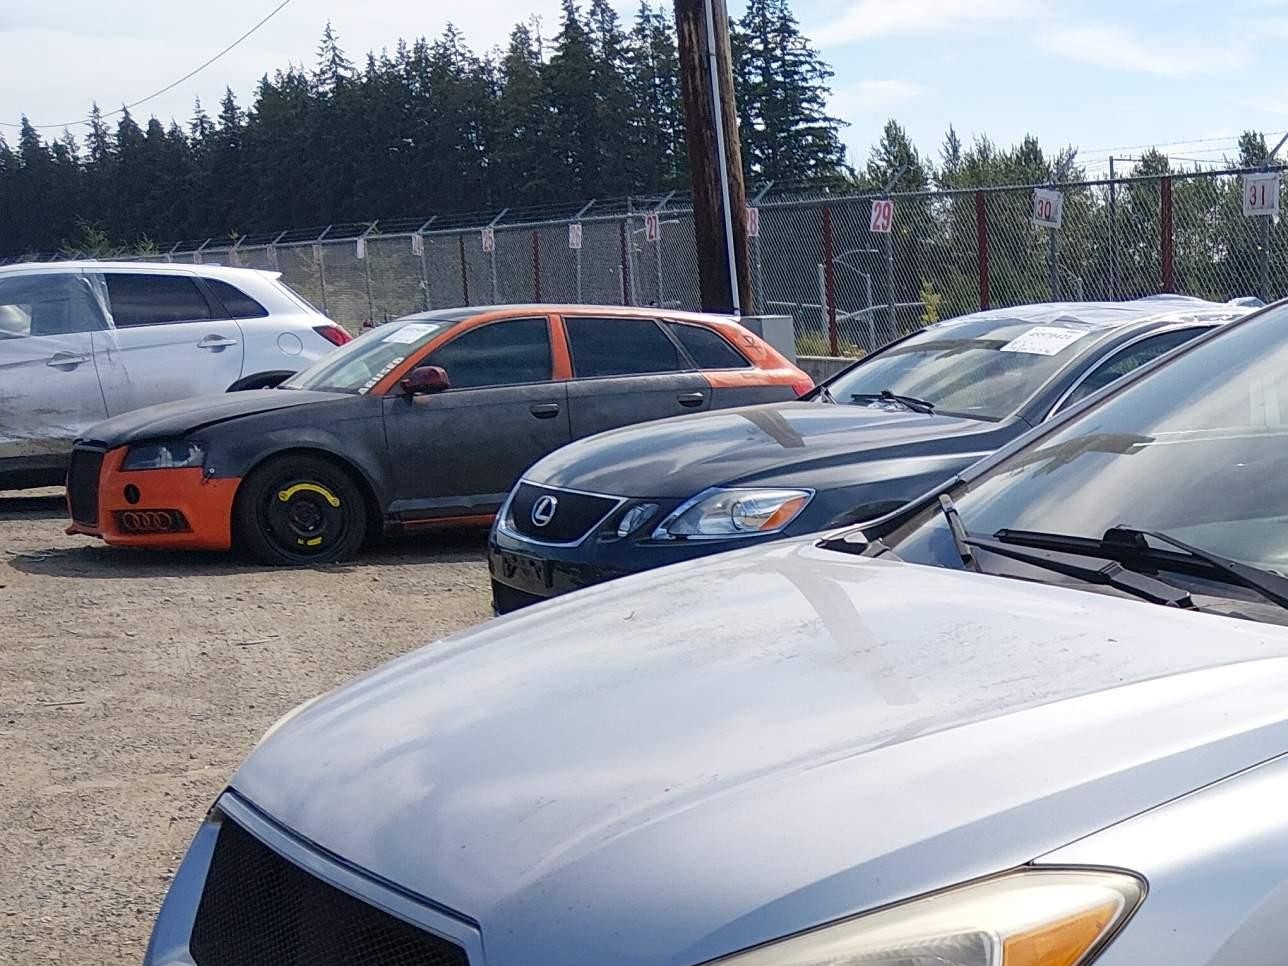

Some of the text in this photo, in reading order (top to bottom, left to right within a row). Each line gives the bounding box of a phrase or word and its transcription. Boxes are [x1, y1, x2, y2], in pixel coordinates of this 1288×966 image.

[1249, 184, 1265, 206] 31
[872, 202, 891, 231] 29
[1037, 199, 1052, 220] 30
